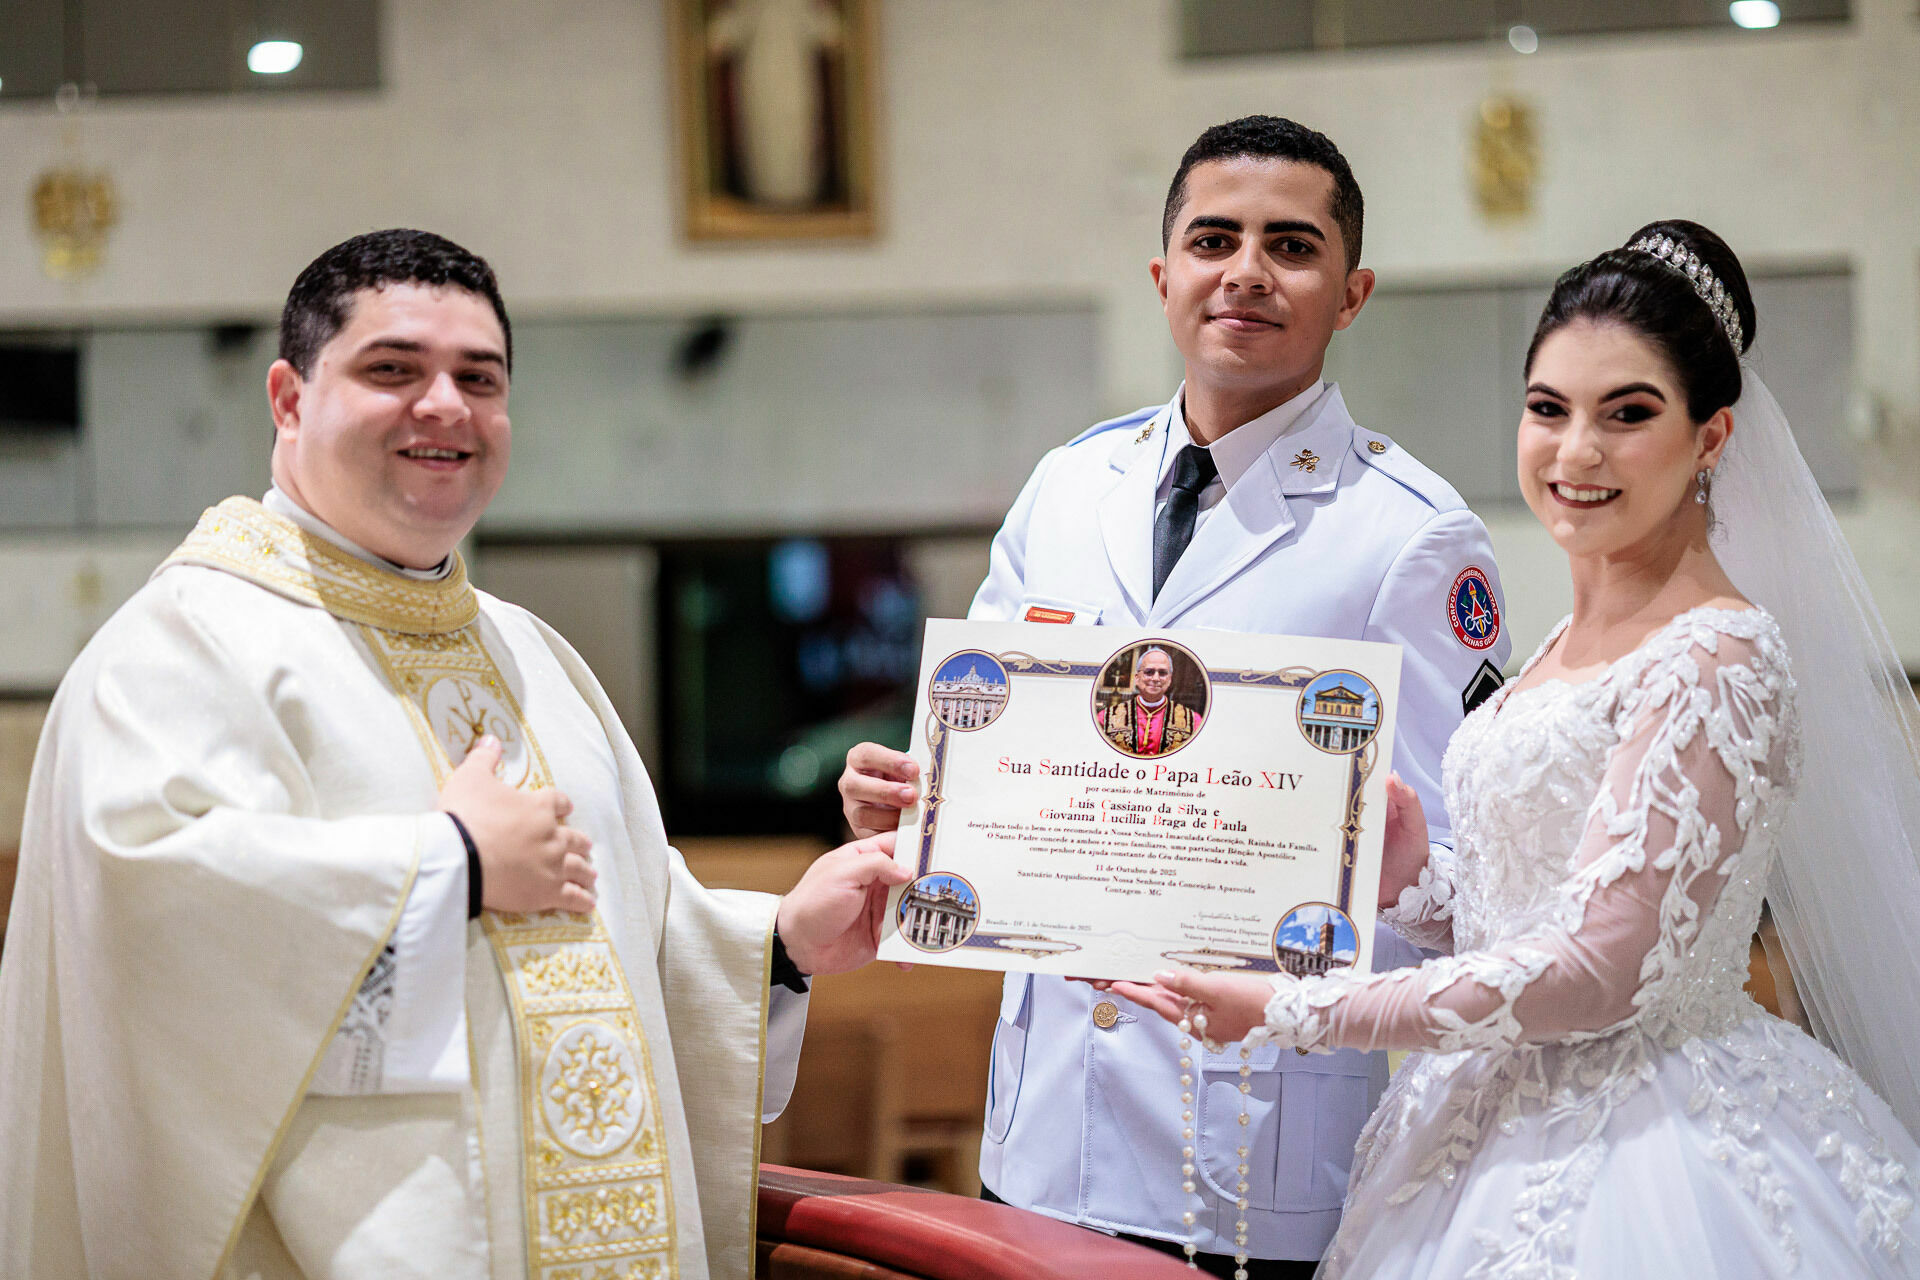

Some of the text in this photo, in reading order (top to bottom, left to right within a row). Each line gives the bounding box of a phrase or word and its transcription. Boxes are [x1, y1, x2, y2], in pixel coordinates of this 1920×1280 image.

[1463, 634, 1484, 647] MINAS
[998, 756, 1304, 792] Sua Santidade o Papa Leão XIV
[1101, 800, 1152, 812] Cassiano
[1158, 803, 1171, 814] da
[1177, 804, 1207, 816] Silva
[1040, 808, 1095, 822] Giovanna
[1153, 815, 1186, 829] Braga
[1192, 818, 1207, 828] de
[1214, 819, 1247, 832] Paula
[1166, 832, 1204, 841] Imaculada
[1248, 838, 1274, 848] Rainha
[1188, 844, 1225, 854] particular
[1174, 854, 1203, 862] durante
[1105, 886, 1141, 895] Contagem
[1219, 884, 1256, 894] Aparecida
